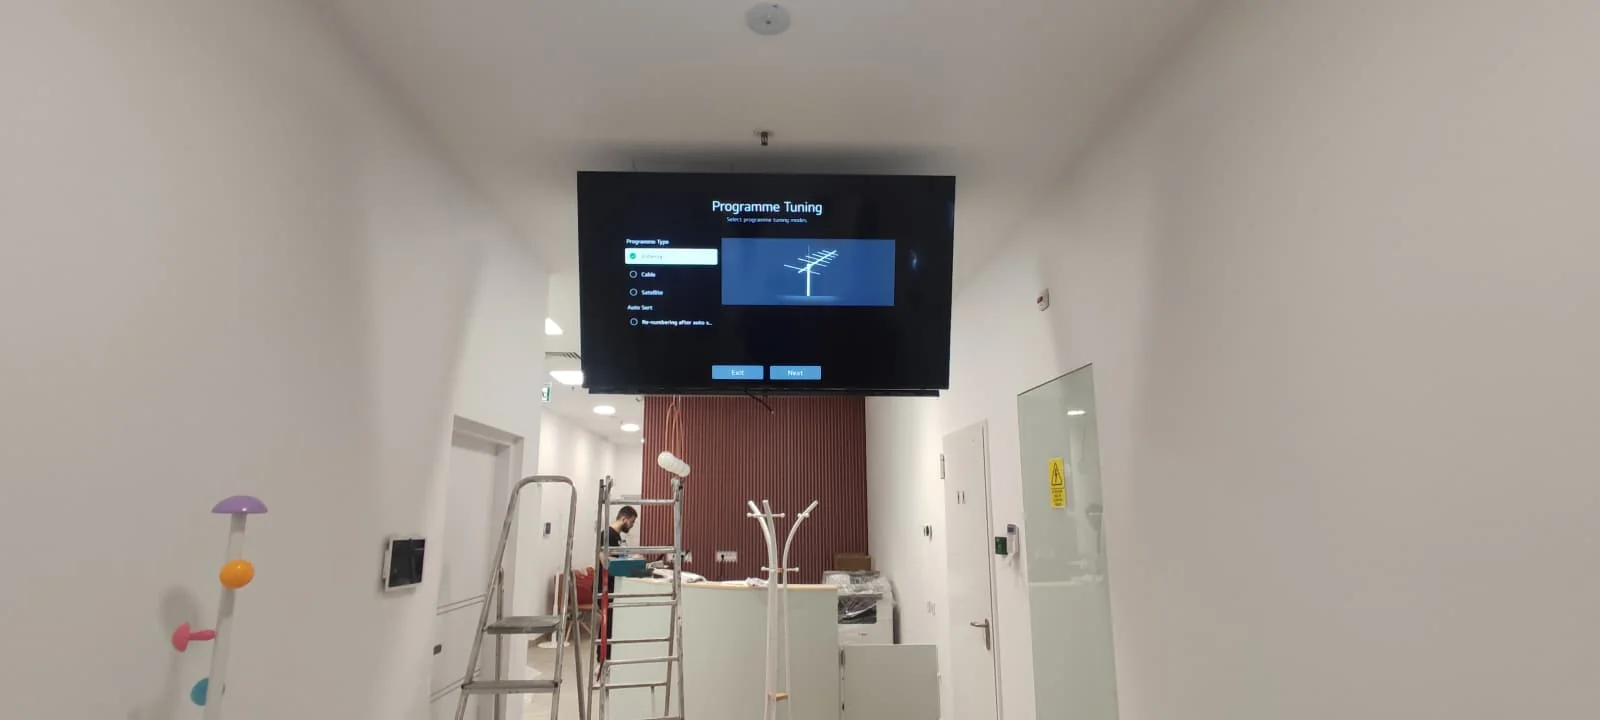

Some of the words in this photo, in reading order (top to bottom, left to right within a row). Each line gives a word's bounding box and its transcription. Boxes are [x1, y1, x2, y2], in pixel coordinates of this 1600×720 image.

[712, 200, 780, 214] Programme
[784, 201, 822, 216] Tuning
[625, 238, 656, 246] Programme
[657, 238, 670, 246] Type
[787, 369, 804, 377] Next
